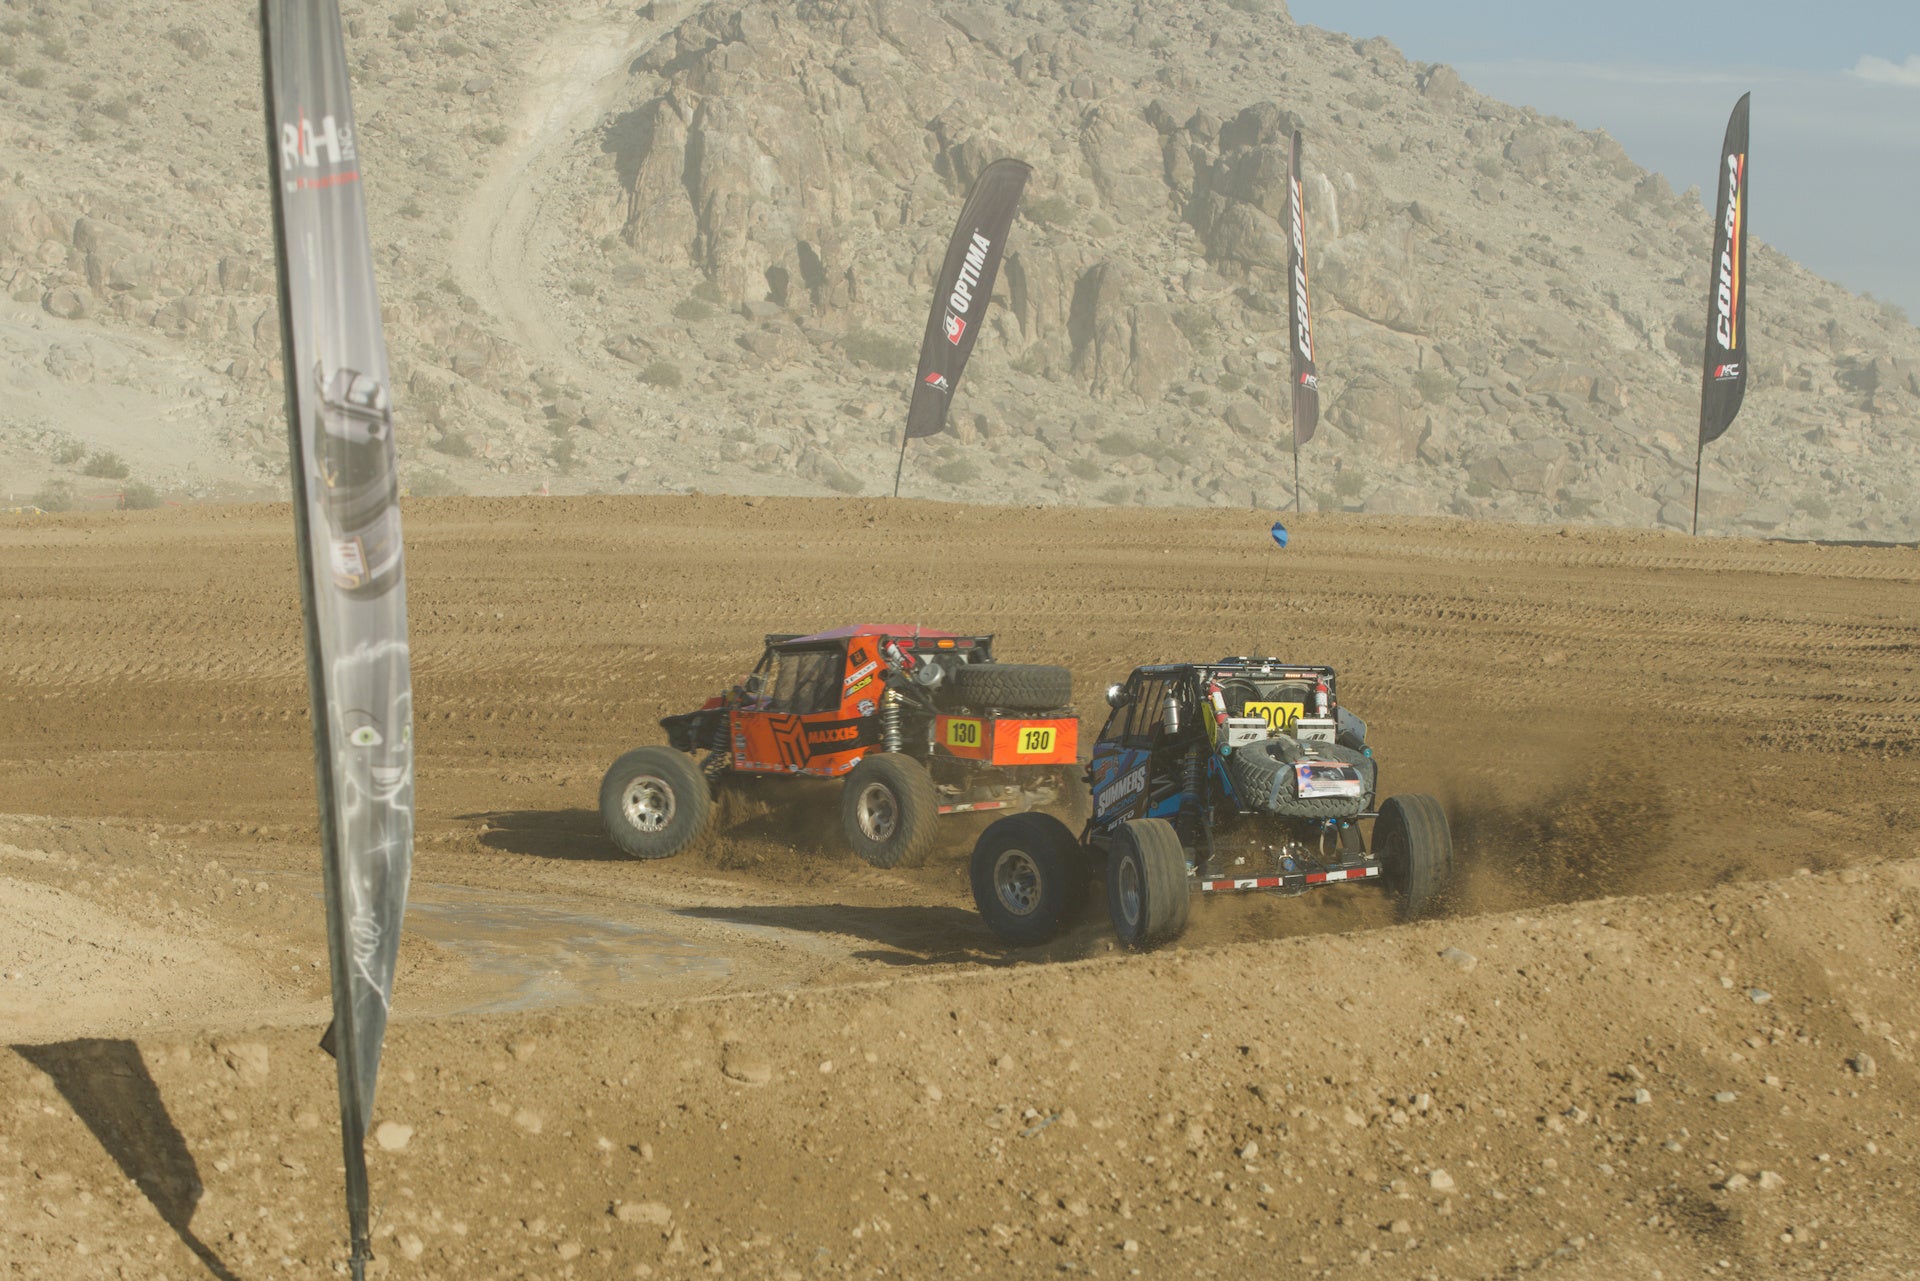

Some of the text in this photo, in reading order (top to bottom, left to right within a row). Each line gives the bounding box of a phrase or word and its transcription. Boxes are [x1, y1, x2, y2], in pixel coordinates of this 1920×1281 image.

[950, 231, 991, 314] OPTIMA
[808, 725, 859, 744] MAXXIS
[952, 722, 976, 744] 130
[1025, 730, 1050, 750] 130
[1096, 765, 1146, 818] SUMMERS
